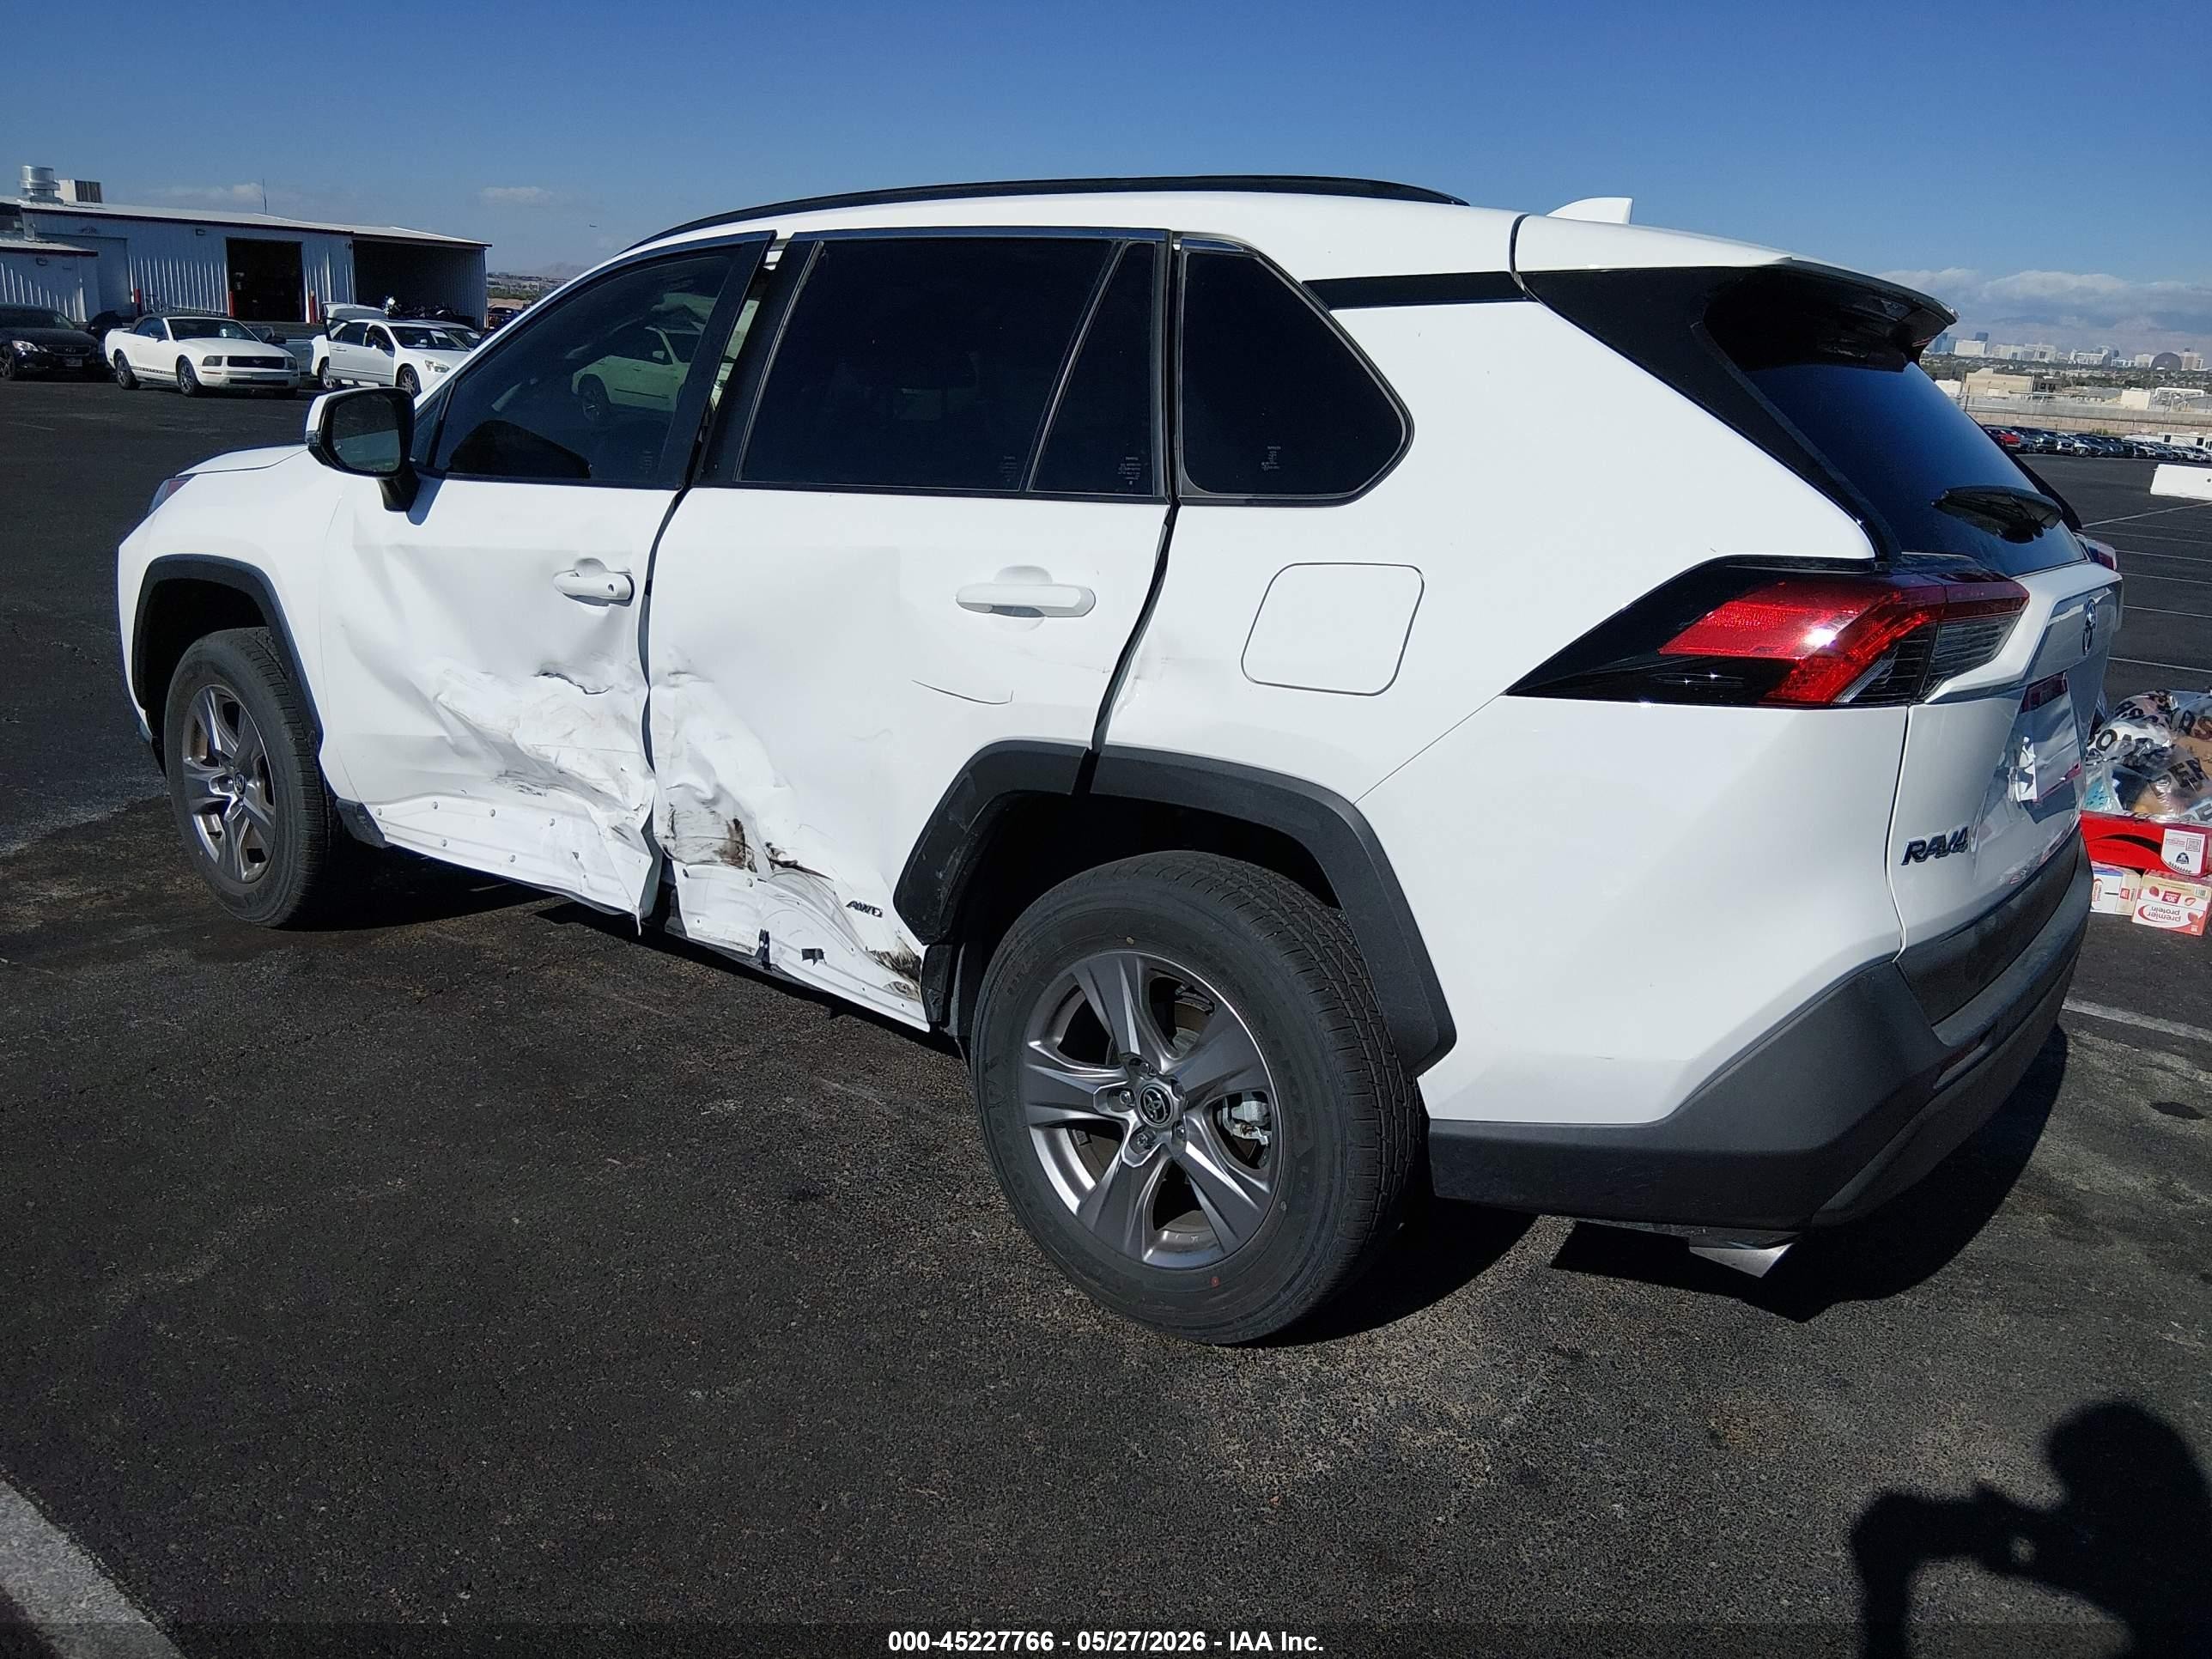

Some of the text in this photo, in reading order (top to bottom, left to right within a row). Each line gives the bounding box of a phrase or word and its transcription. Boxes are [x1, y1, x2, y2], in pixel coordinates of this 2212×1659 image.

[1900, 825, 1969, 866] RAV4
[845, 900, 884, 918] AWD
[2151, 906, 2180, 915] protein
[2147, 911, 2181, 922] premier
